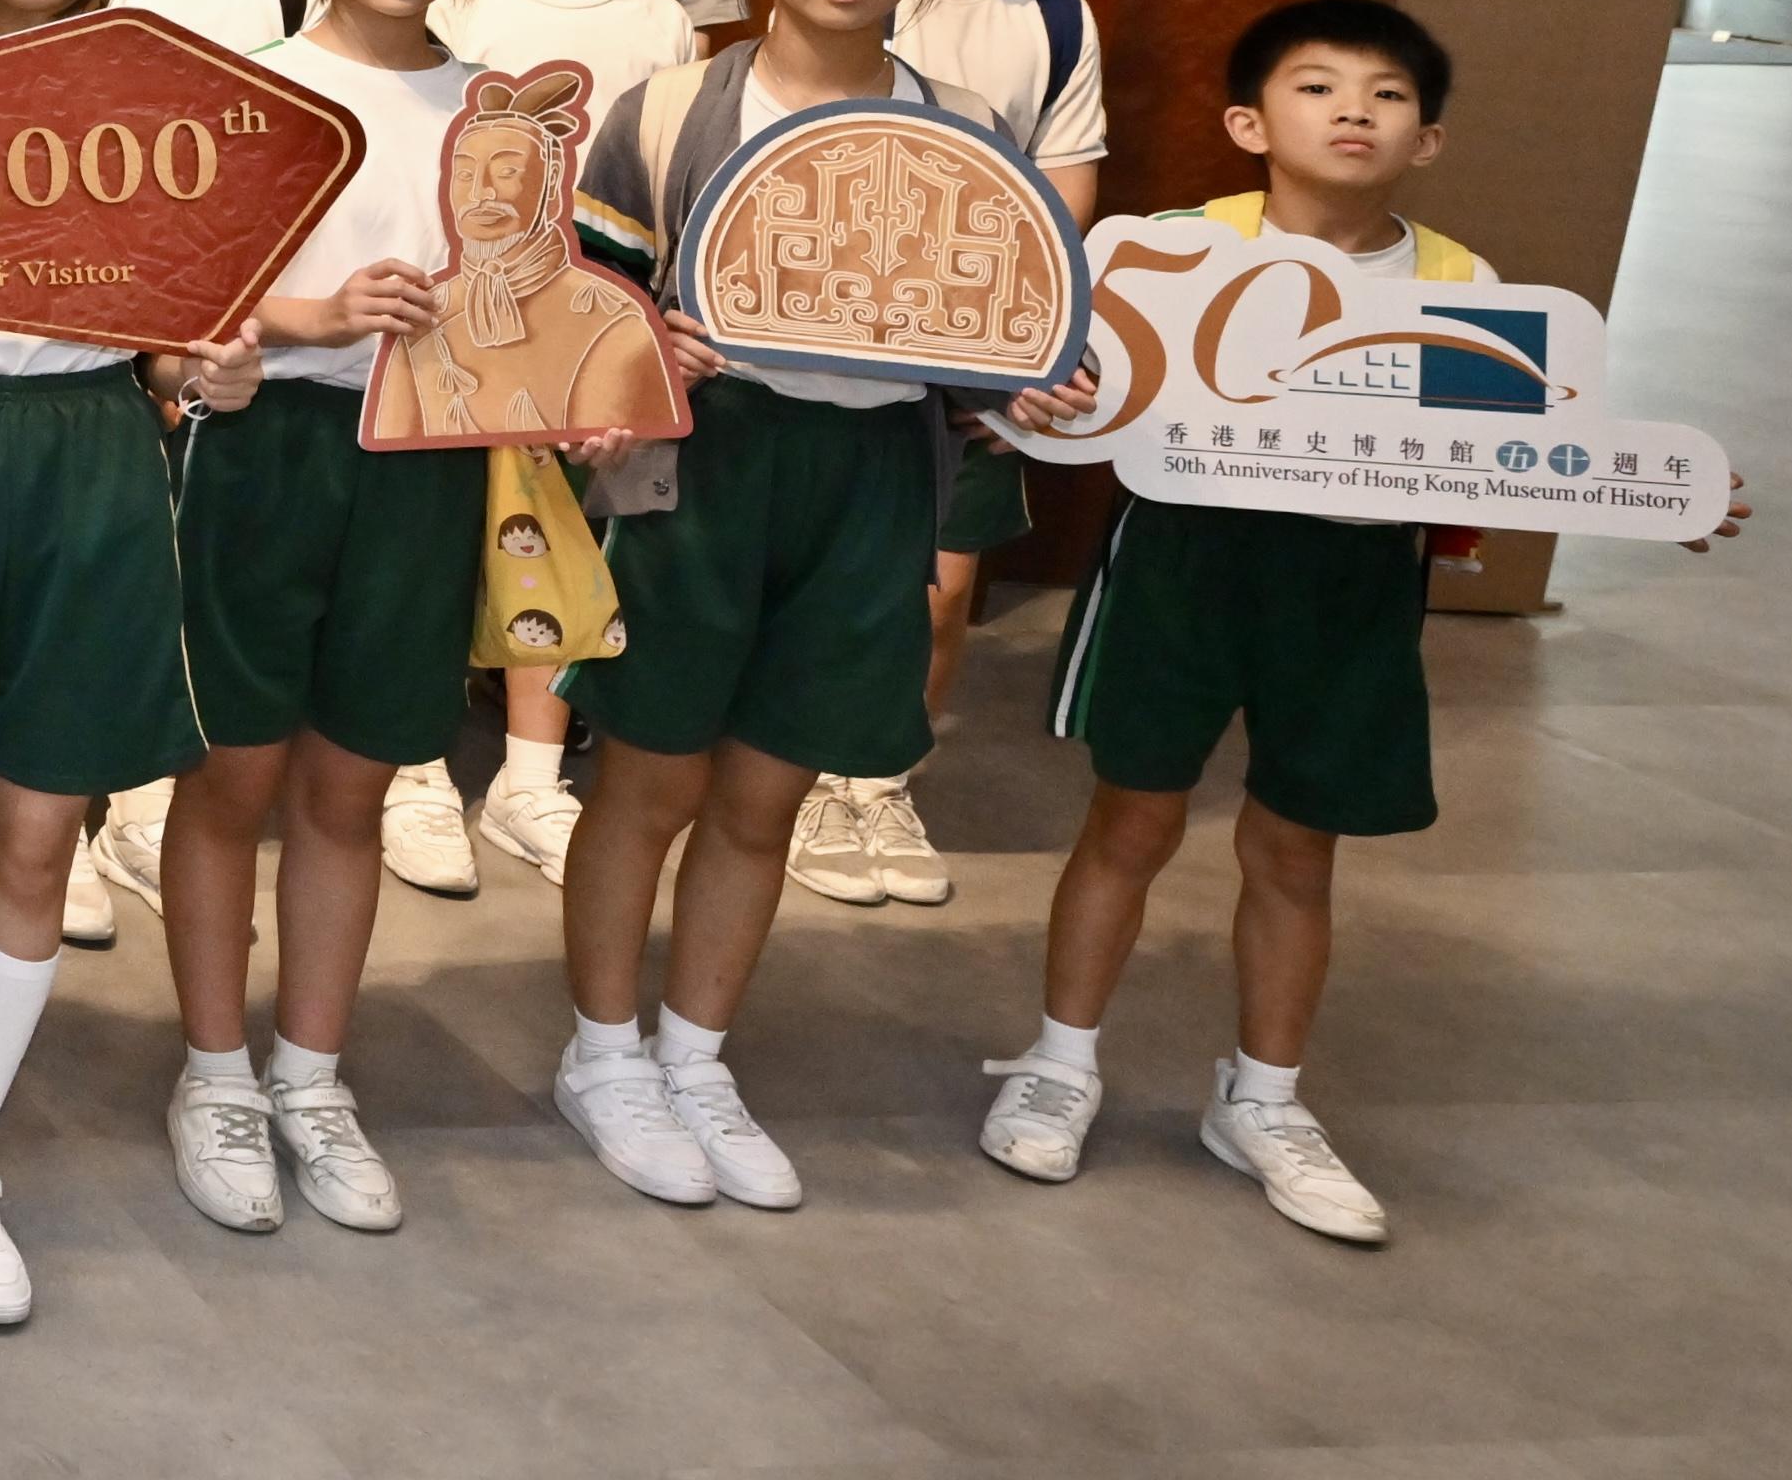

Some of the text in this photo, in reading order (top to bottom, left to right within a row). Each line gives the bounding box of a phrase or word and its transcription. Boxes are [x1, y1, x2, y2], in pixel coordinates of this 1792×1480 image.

[18, 258, 136, 287] Visitor
[1163, 455, 1691, 516] 50th Anniversary of Hong Kong Museum of History
